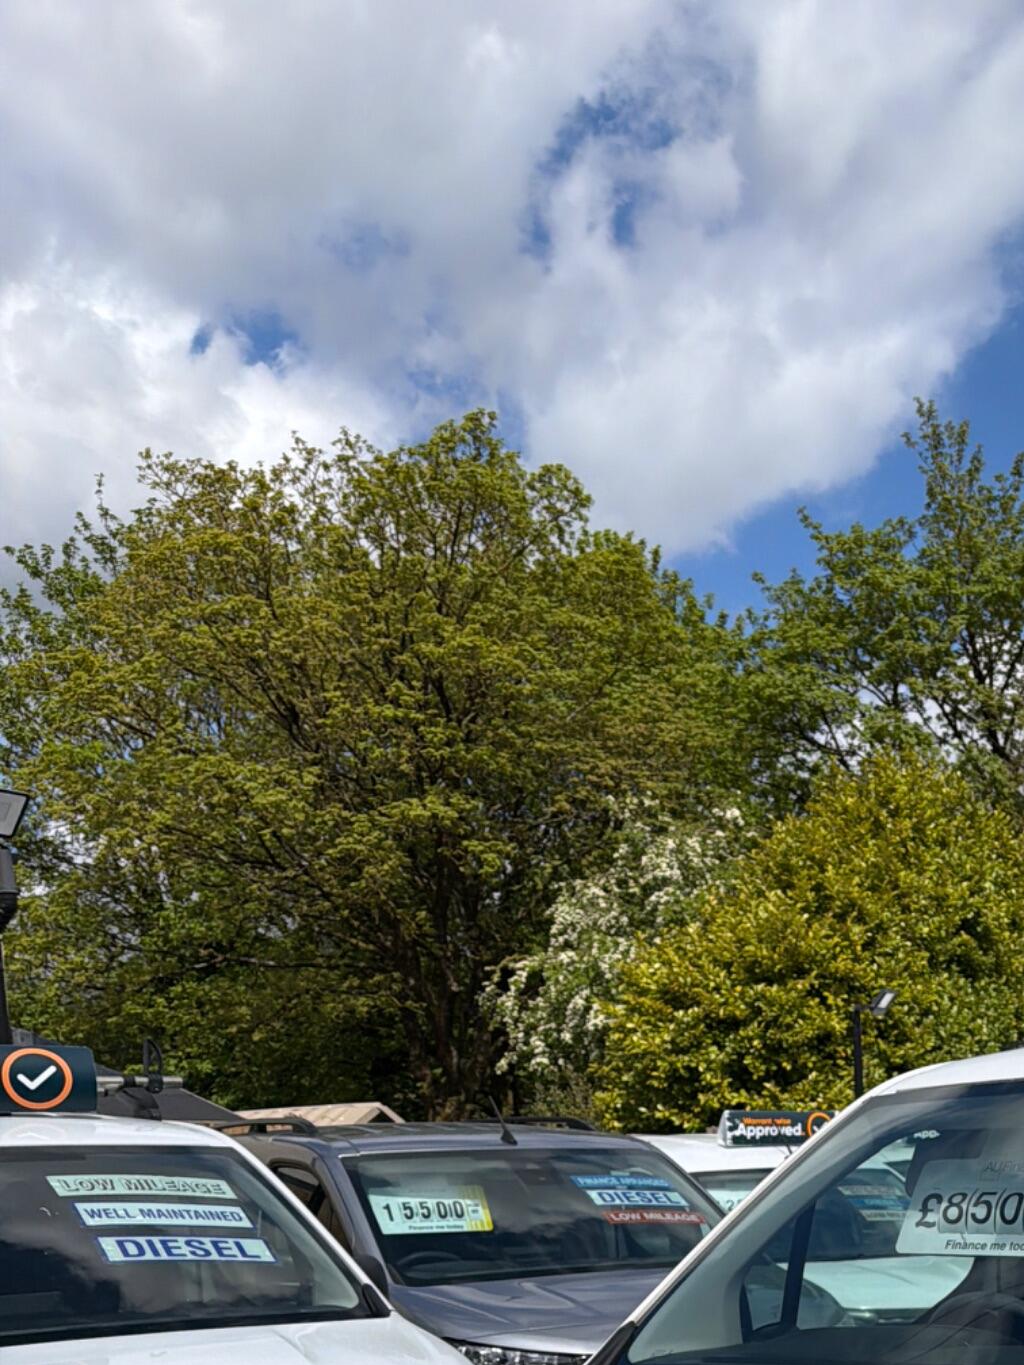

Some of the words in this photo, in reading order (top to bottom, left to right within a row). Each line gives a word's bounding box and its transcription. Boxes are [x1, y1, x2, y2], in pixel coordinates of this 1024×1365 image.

[57, 1178, 115, 1193] LOW
[122, 1178, 226, 1195] MILEAGE
[598, 1191, 682, 1205] DIESEL
[84, 1207, 136, 1220] WELL
[140, 1208, 243, 1222] MAINTAINED
[114, 1238, 262, 1259] DIESEL
[944, 1239, 987, 1251] Finance
[989, 1242, 1007, 1251] me
